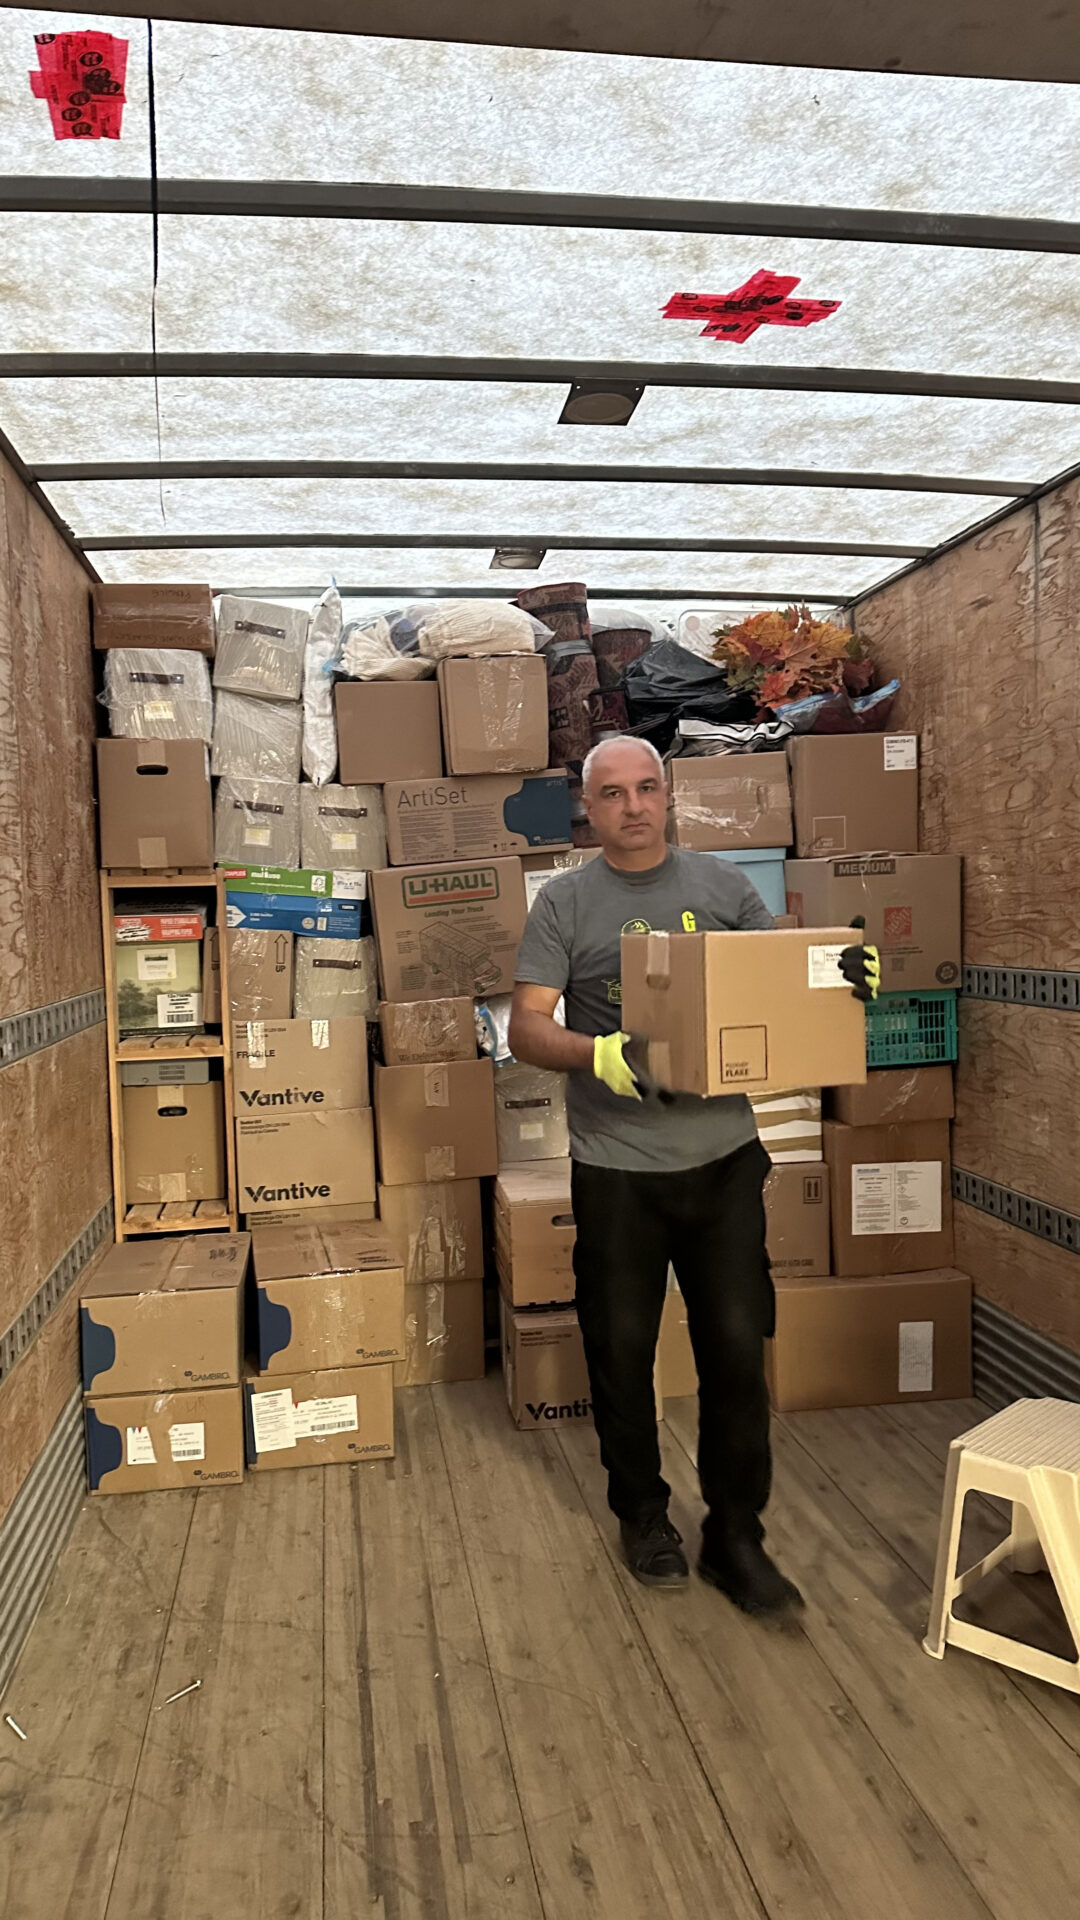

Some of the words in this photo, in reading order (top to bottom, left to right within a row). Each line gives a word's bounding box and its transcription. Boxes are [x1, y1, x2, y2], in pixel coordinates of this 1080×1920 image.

[397, 786, 468, 809] ArtiSet
[839, 862, 892, 875] MEDIUM
[408, 873, 493, 896] U-HAUL
[275, 965, 286, 973] UP
[239, 1087, 324, 1107] Vantive
[244, 1182, 331, 1203] Vantive
